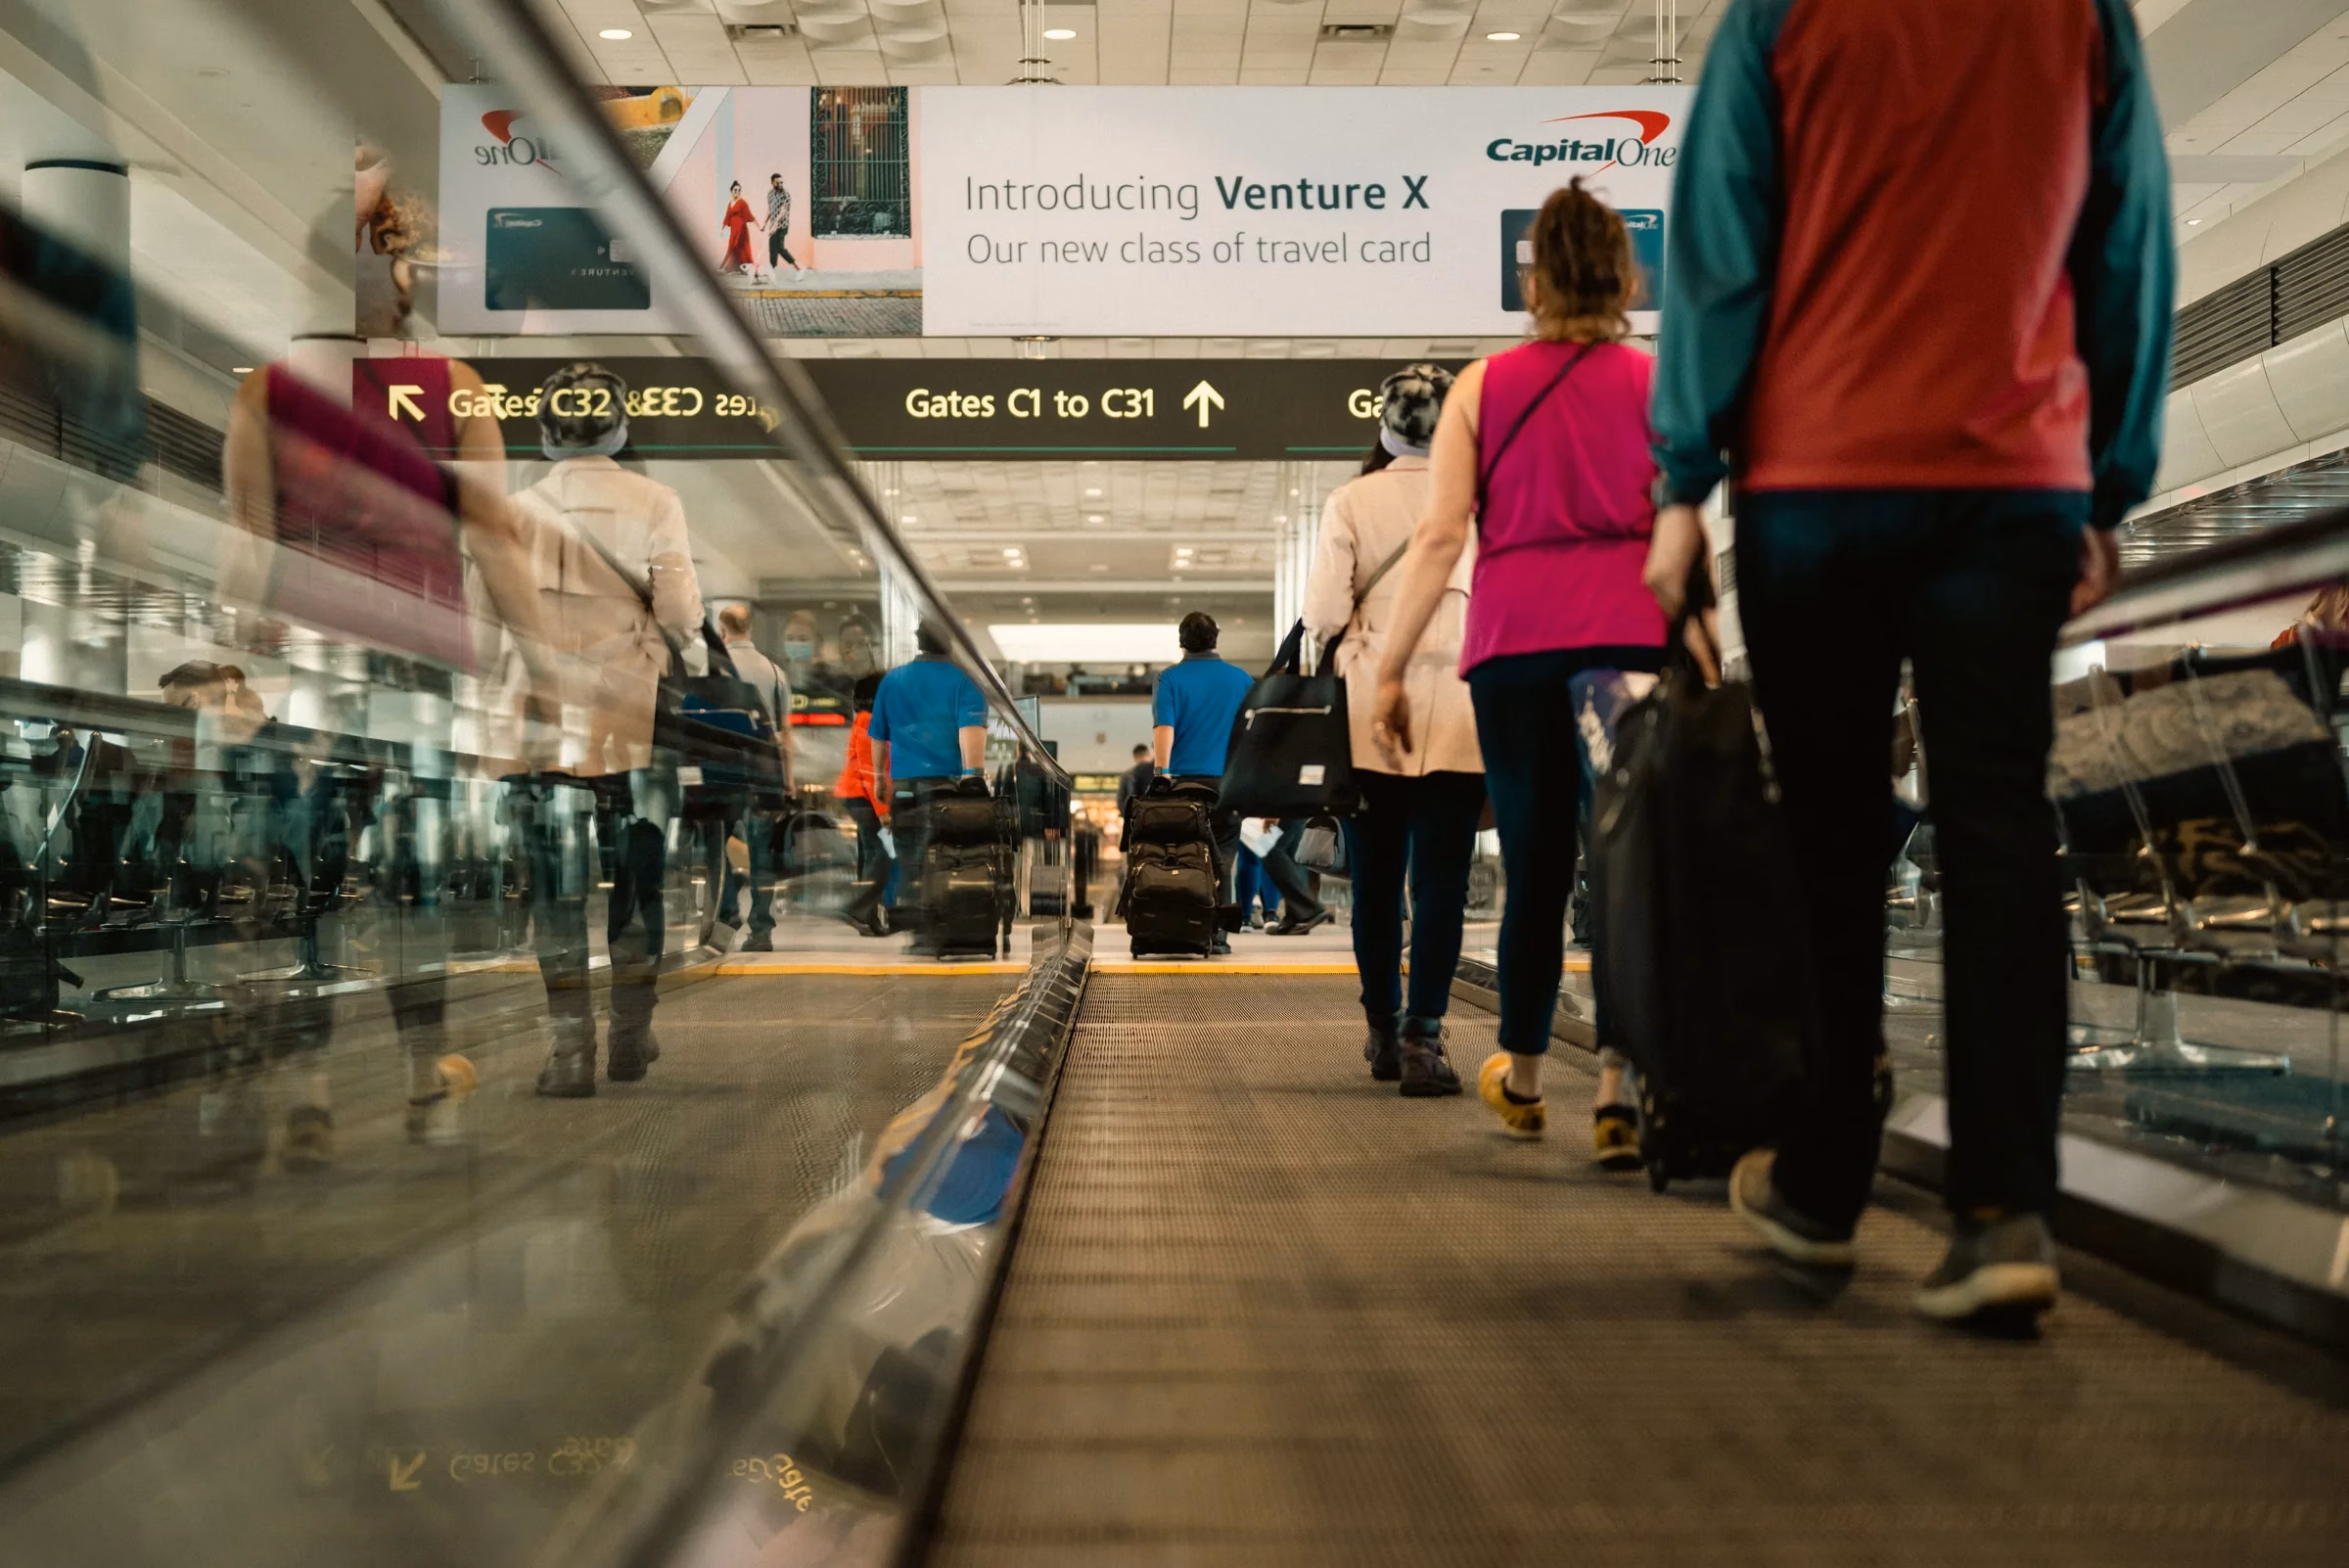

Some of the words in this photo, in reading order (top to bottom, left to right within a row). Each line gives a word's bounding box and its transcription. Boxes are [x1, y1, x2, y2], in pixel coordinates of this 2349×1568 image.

[967, 173, 1199, 221] Introducing
[1215, 175, 1387, 211] Venture
[1401, 174, 1430, 210] X
[967, 233, 1028, 264] Our
[1040, 241, 1109, 263] new
[1120, 231, 1201, 264] class
[1213, 231, 1246, 264] of
[1256, 231, 1348, 264] travel
[1359, 231, 1431, 264] card
[448, 389, 538, 418] Gates
[550, 388, 612, 418] C32
[906, 388, 995, 419] Gates
[1007, 388, 1041, 418] C1
[1054, 390, 1089, 418] to
[1101, 388, 1154, 418] C31
